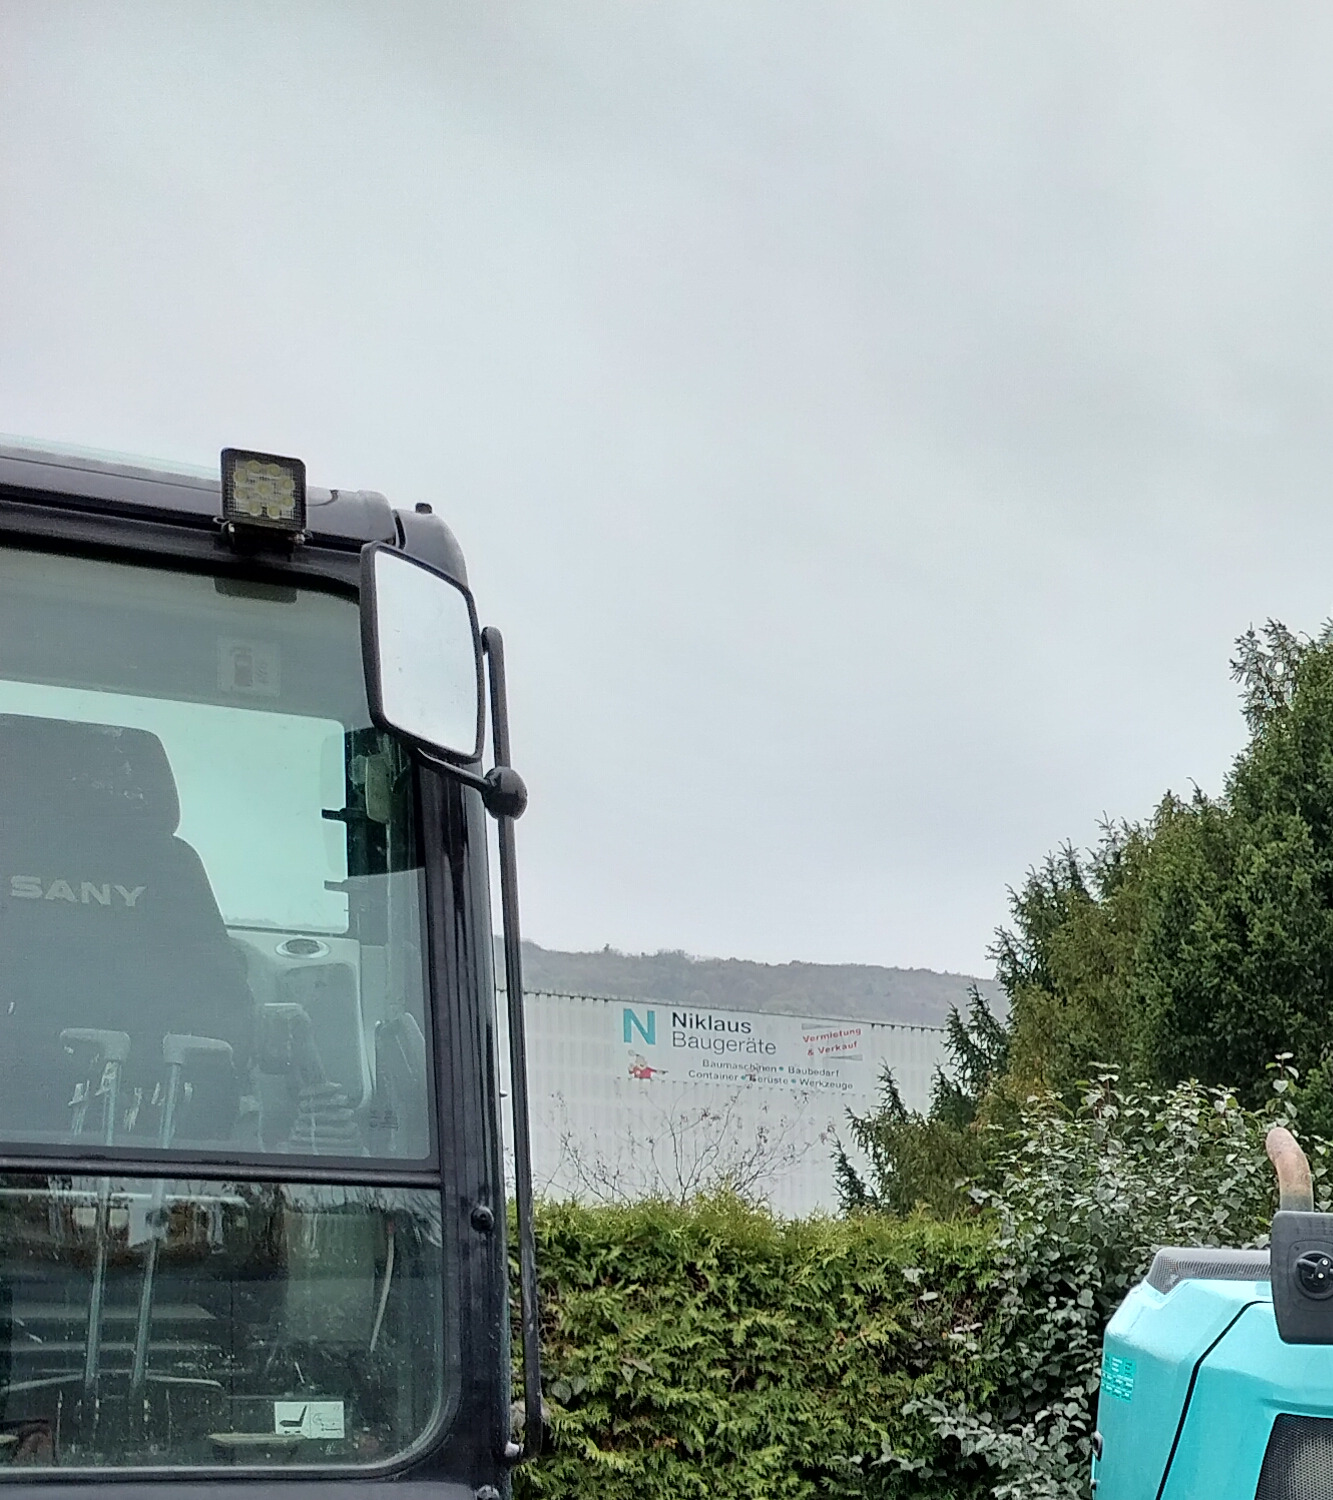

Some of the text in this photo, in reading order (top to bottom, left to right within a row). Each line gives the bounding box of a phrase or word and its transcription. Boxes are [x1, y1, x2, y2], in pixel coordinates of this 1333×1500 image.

[9, 875, 147, 907] SANY
[622, 1008, 656, 1046] N
[672, 1012, 752, 1034] Niklaus
[672, 1031, 777, 1056] Baugeräte
[802, 1027, 862, 1044] Vermietung
[818, 1041, 858, 1054] Verkauf
[688, 1070, 739, 1082] Container
[800, 1077, 853, 1091] Werkzeuge
